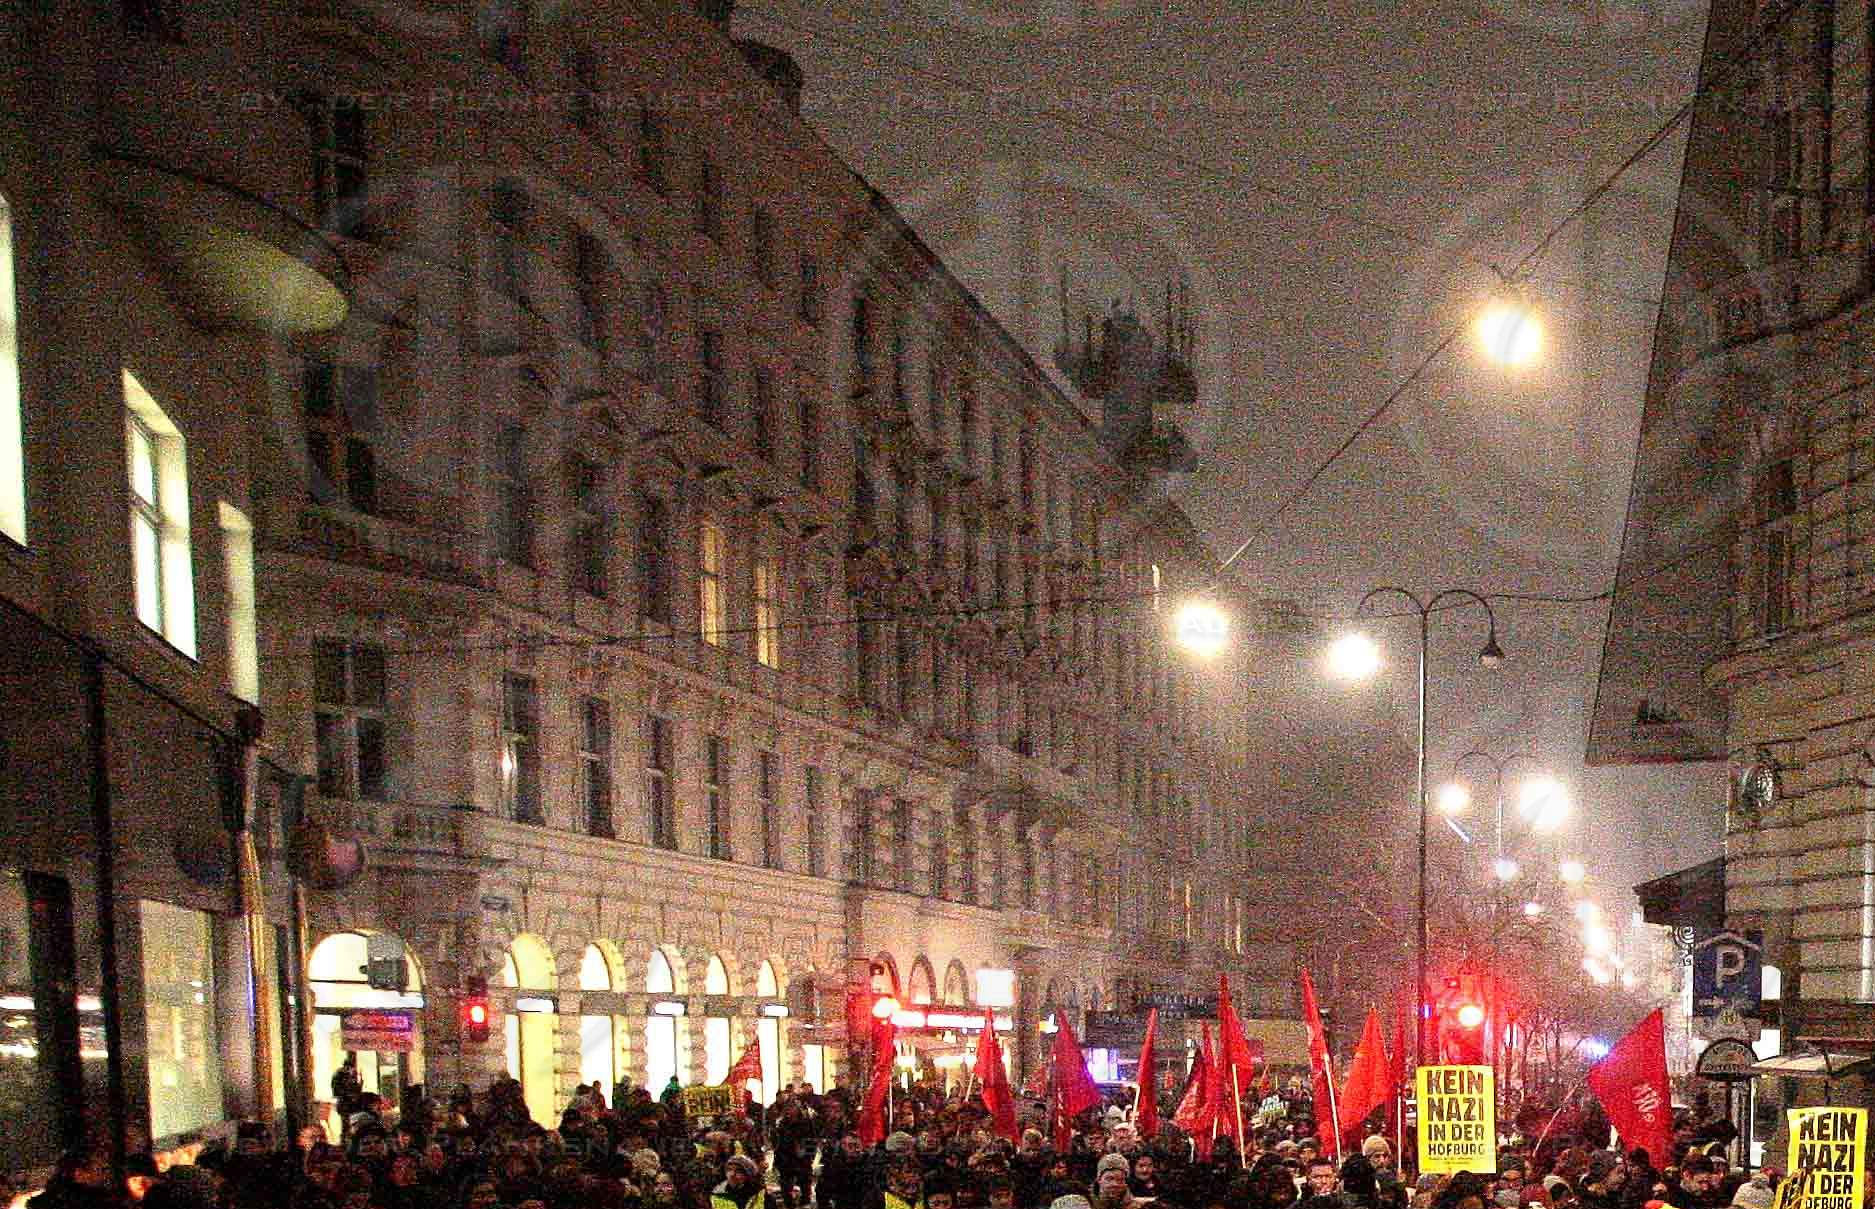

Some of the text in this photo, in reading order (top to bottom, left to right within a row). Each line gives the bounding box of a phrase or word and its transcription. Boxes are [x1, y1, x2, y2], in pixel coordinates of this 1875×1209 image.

[1427, 1070, 1484, 1095] KEIN
[1428, 1097, 1484, 1121] NAZI
[1428, 1124, 1485, 1141] IN DER
[1799, 1112, 1857, 1142] KEIN
[1428, 1143, 1486, 1156] HOFBURG
[1798, 1143, 1855, 1173] NAZI
[1820, 1174, 1854, 1195] DER
